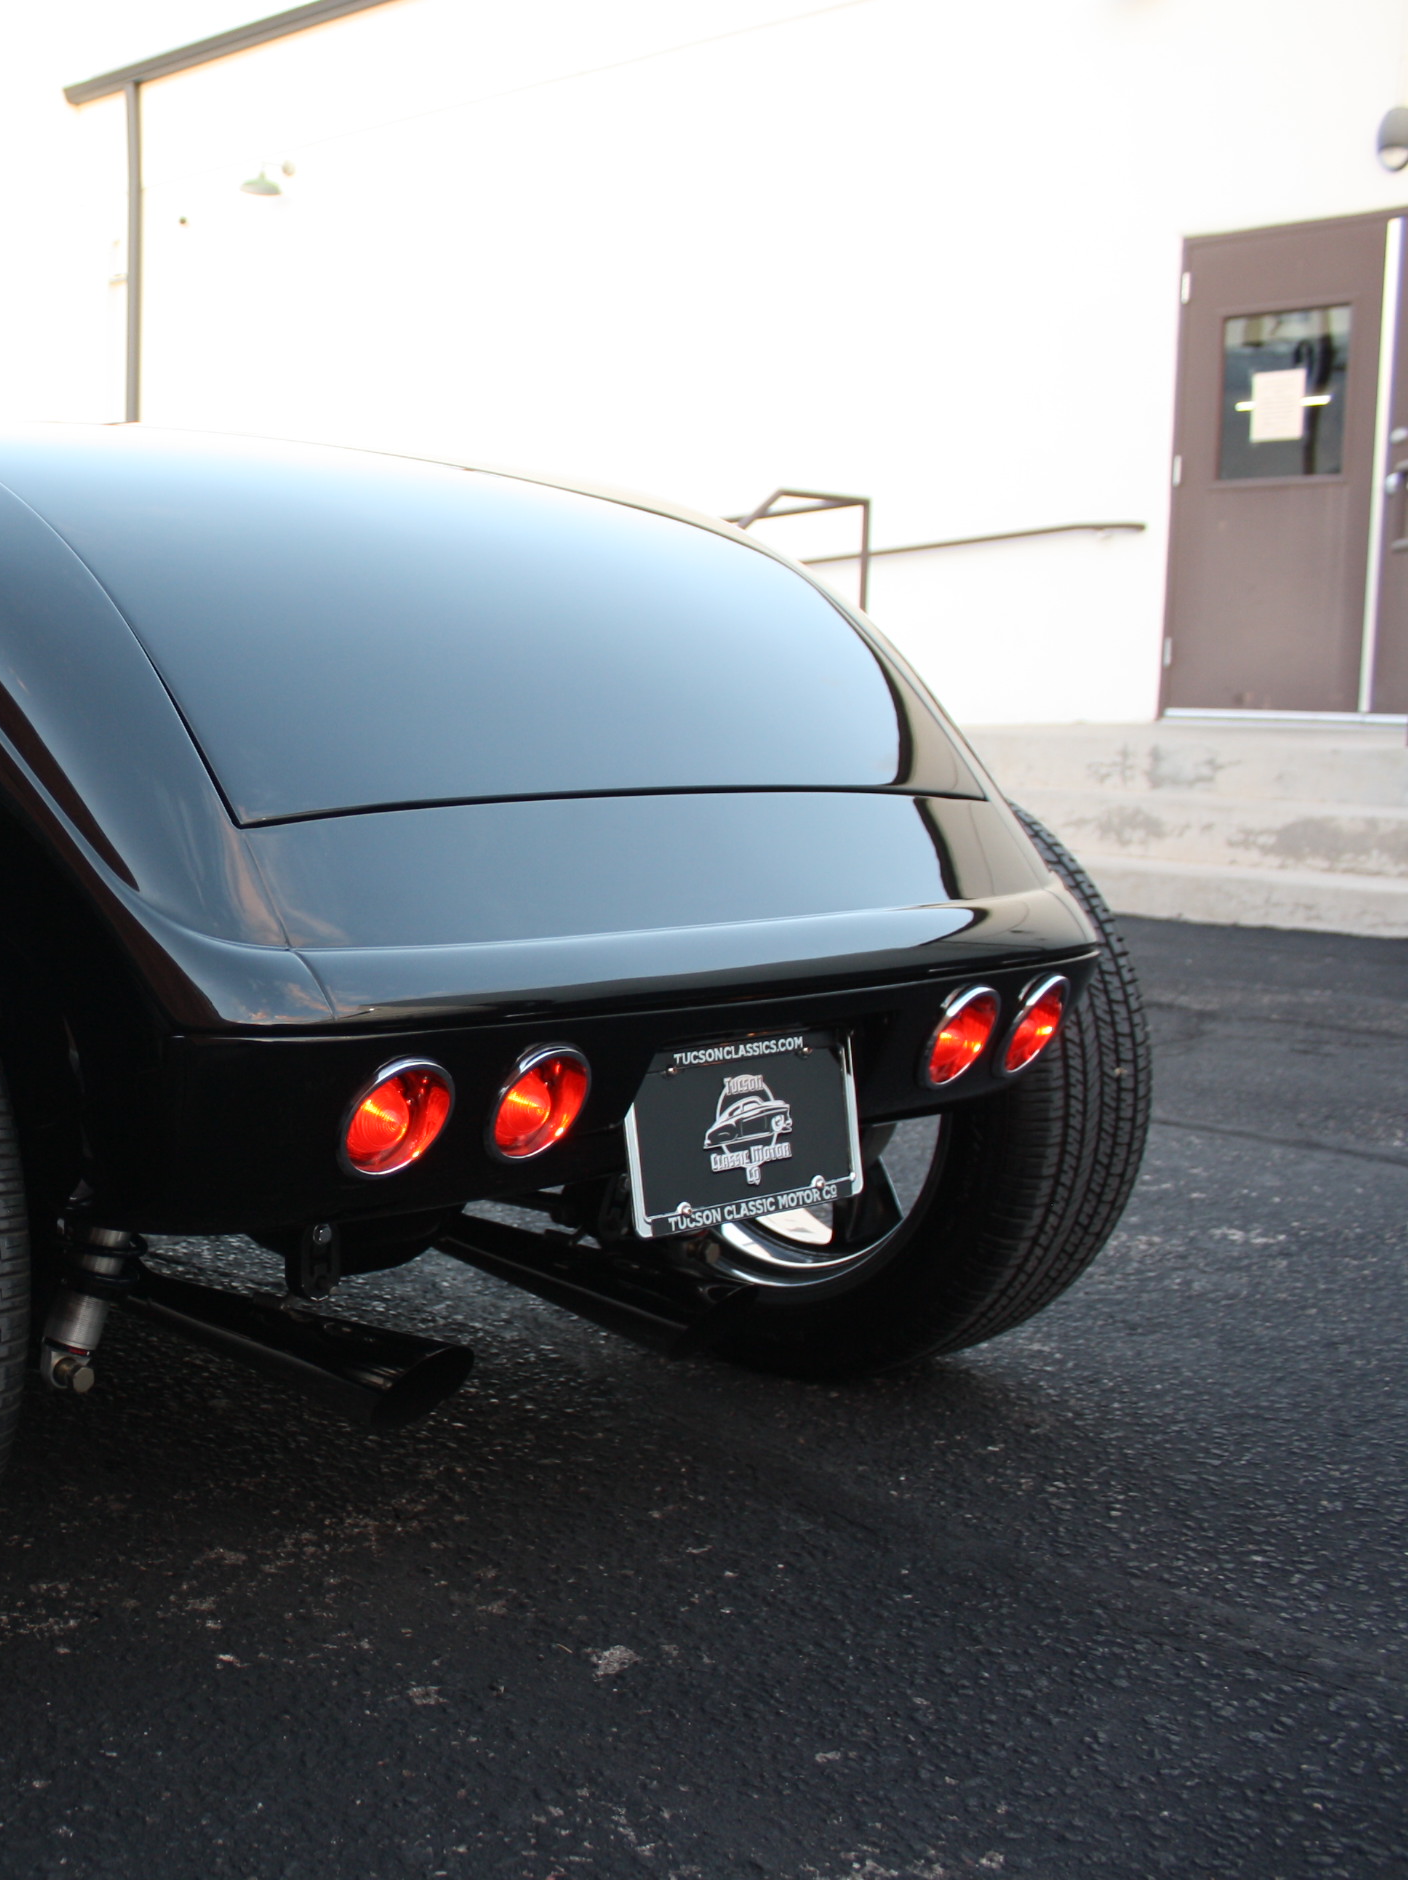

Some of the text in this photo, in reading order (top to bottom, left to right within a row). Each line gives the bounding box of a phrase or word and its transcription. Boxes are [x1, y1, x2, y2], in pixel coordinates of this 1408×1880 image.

[673, 1036, 804, 1065] TUCSONCLASSICS.COM
[668, 1208, 722, 1231] TUCSON
[724, 1197, 776, 1220] CLASSIC
[778, 1188, 821, 1209] MOTOR
